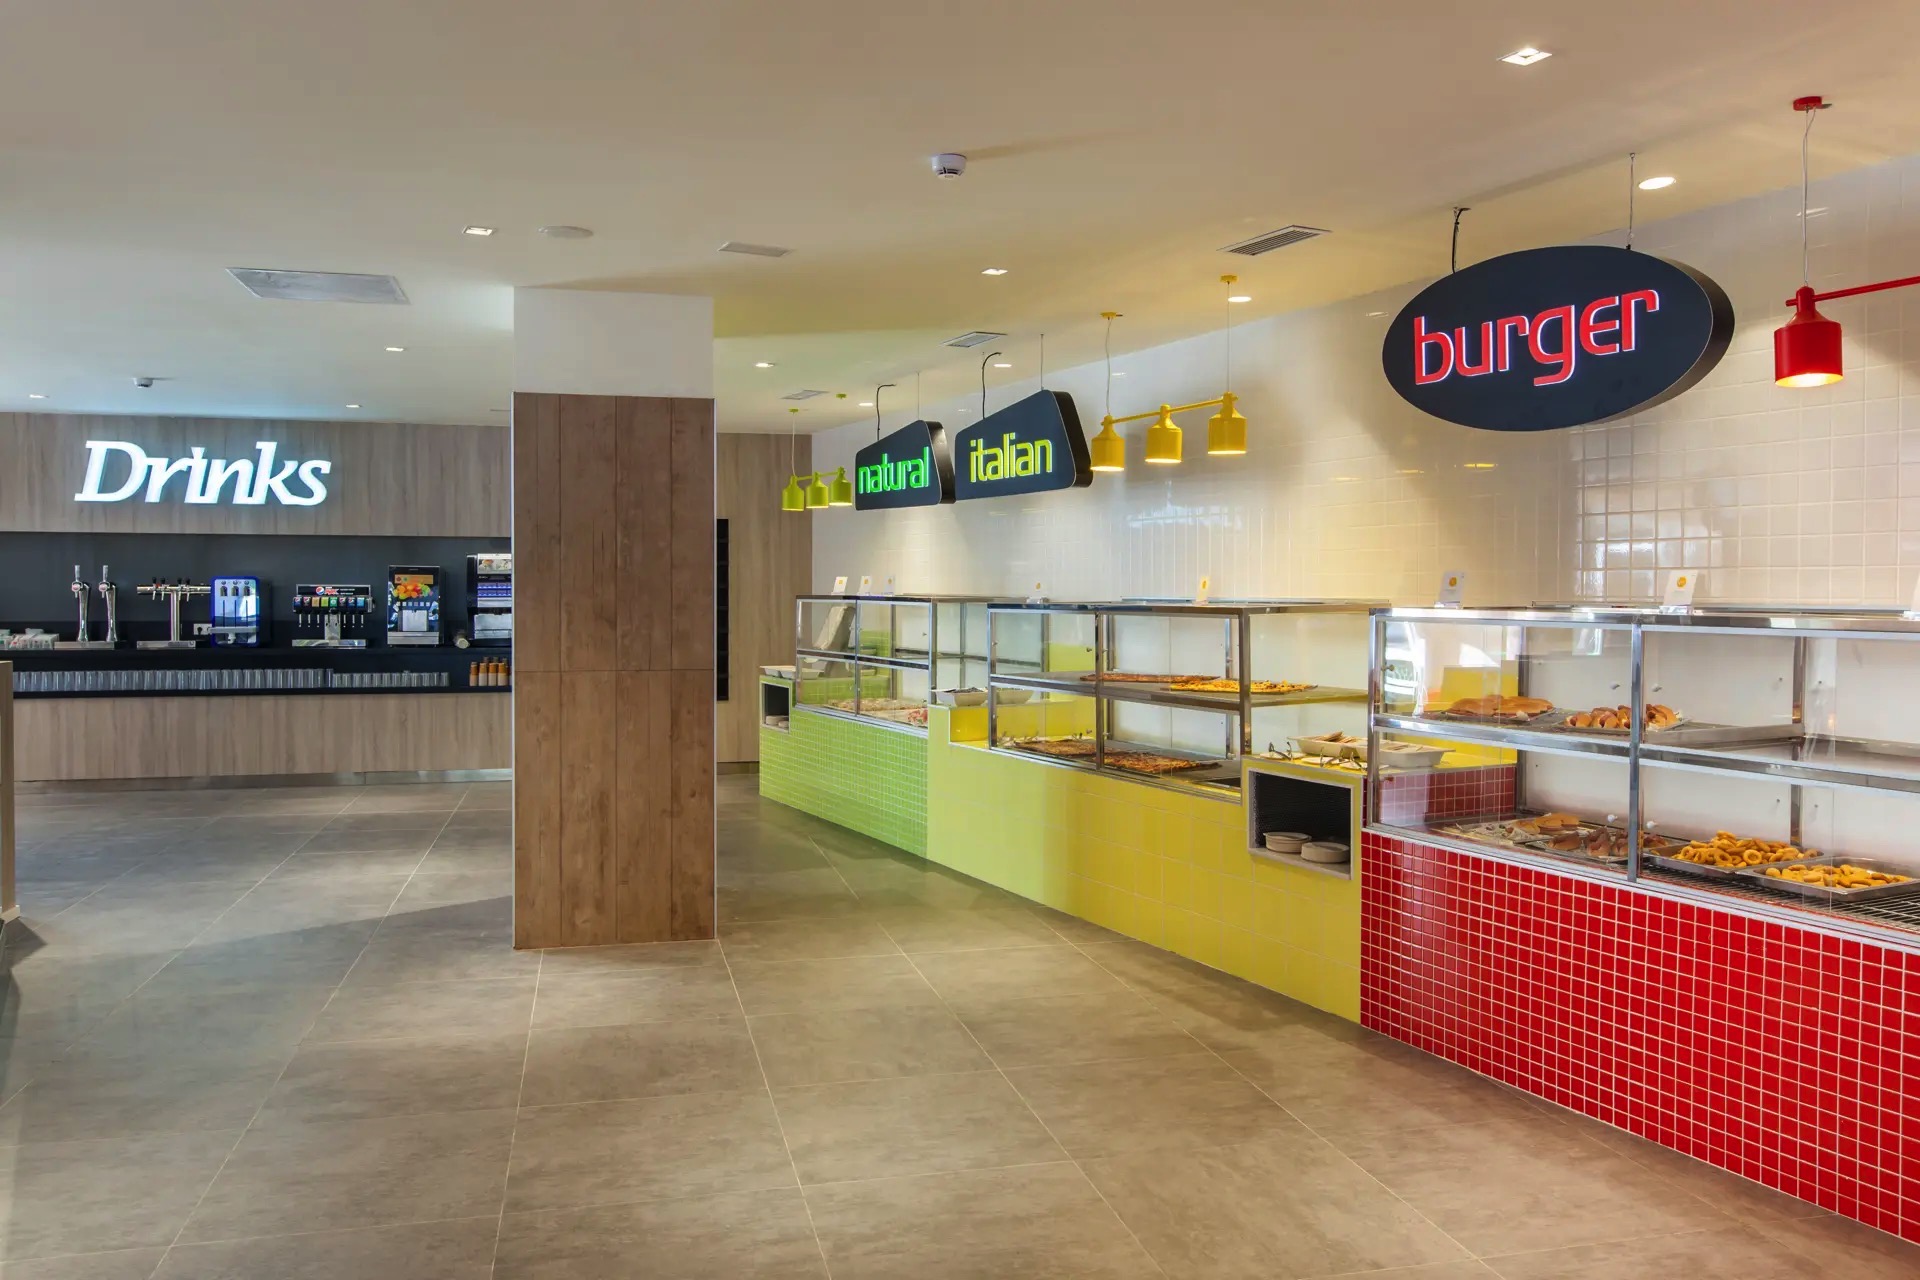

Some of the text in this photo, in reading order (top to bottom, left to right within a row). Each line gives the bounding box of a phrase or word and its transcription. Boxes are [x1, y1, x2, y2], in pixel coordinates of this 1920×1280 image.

[1413, 289, 1660, 387] burger
[74, 440, 332, 506] Drinks
[858, 446, 930, 494] natural
[970, 432, 1053, 483] italian
